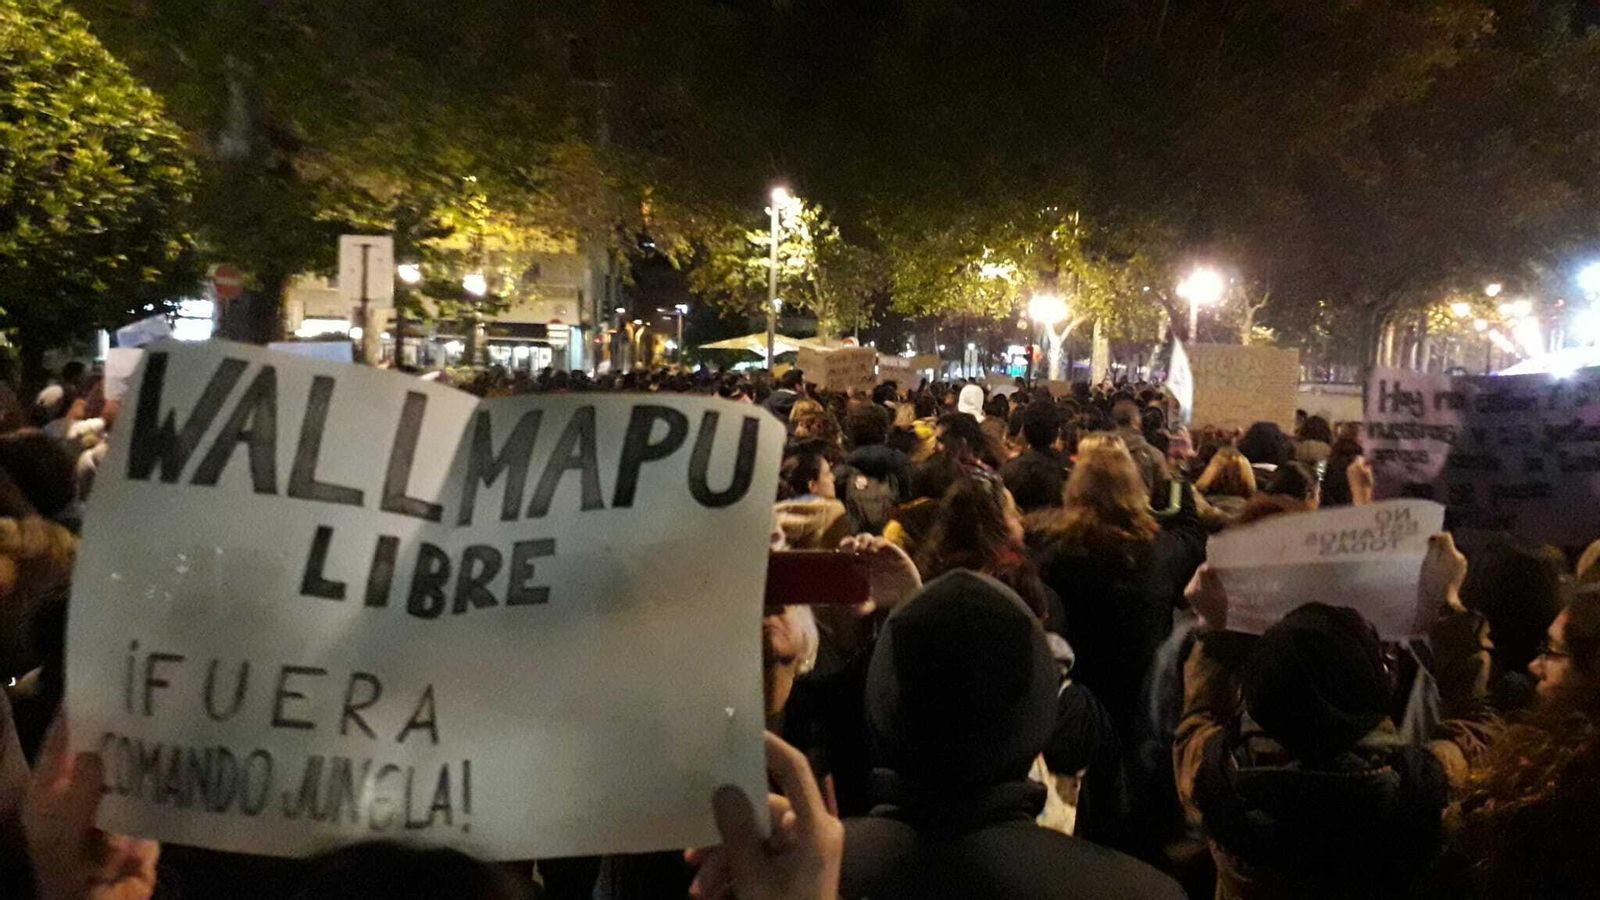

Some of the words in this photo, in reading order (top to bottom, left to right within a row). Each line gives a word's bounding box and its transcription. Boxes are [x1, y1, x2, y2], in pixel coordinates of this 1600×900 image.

[126, 352, 760, 523] WALLMAPU
[301, 525, 556, 619] LIBRE
[99, 732, 273, 816] COMANDO
[281, 754, 472, 833] JUNGLA!
